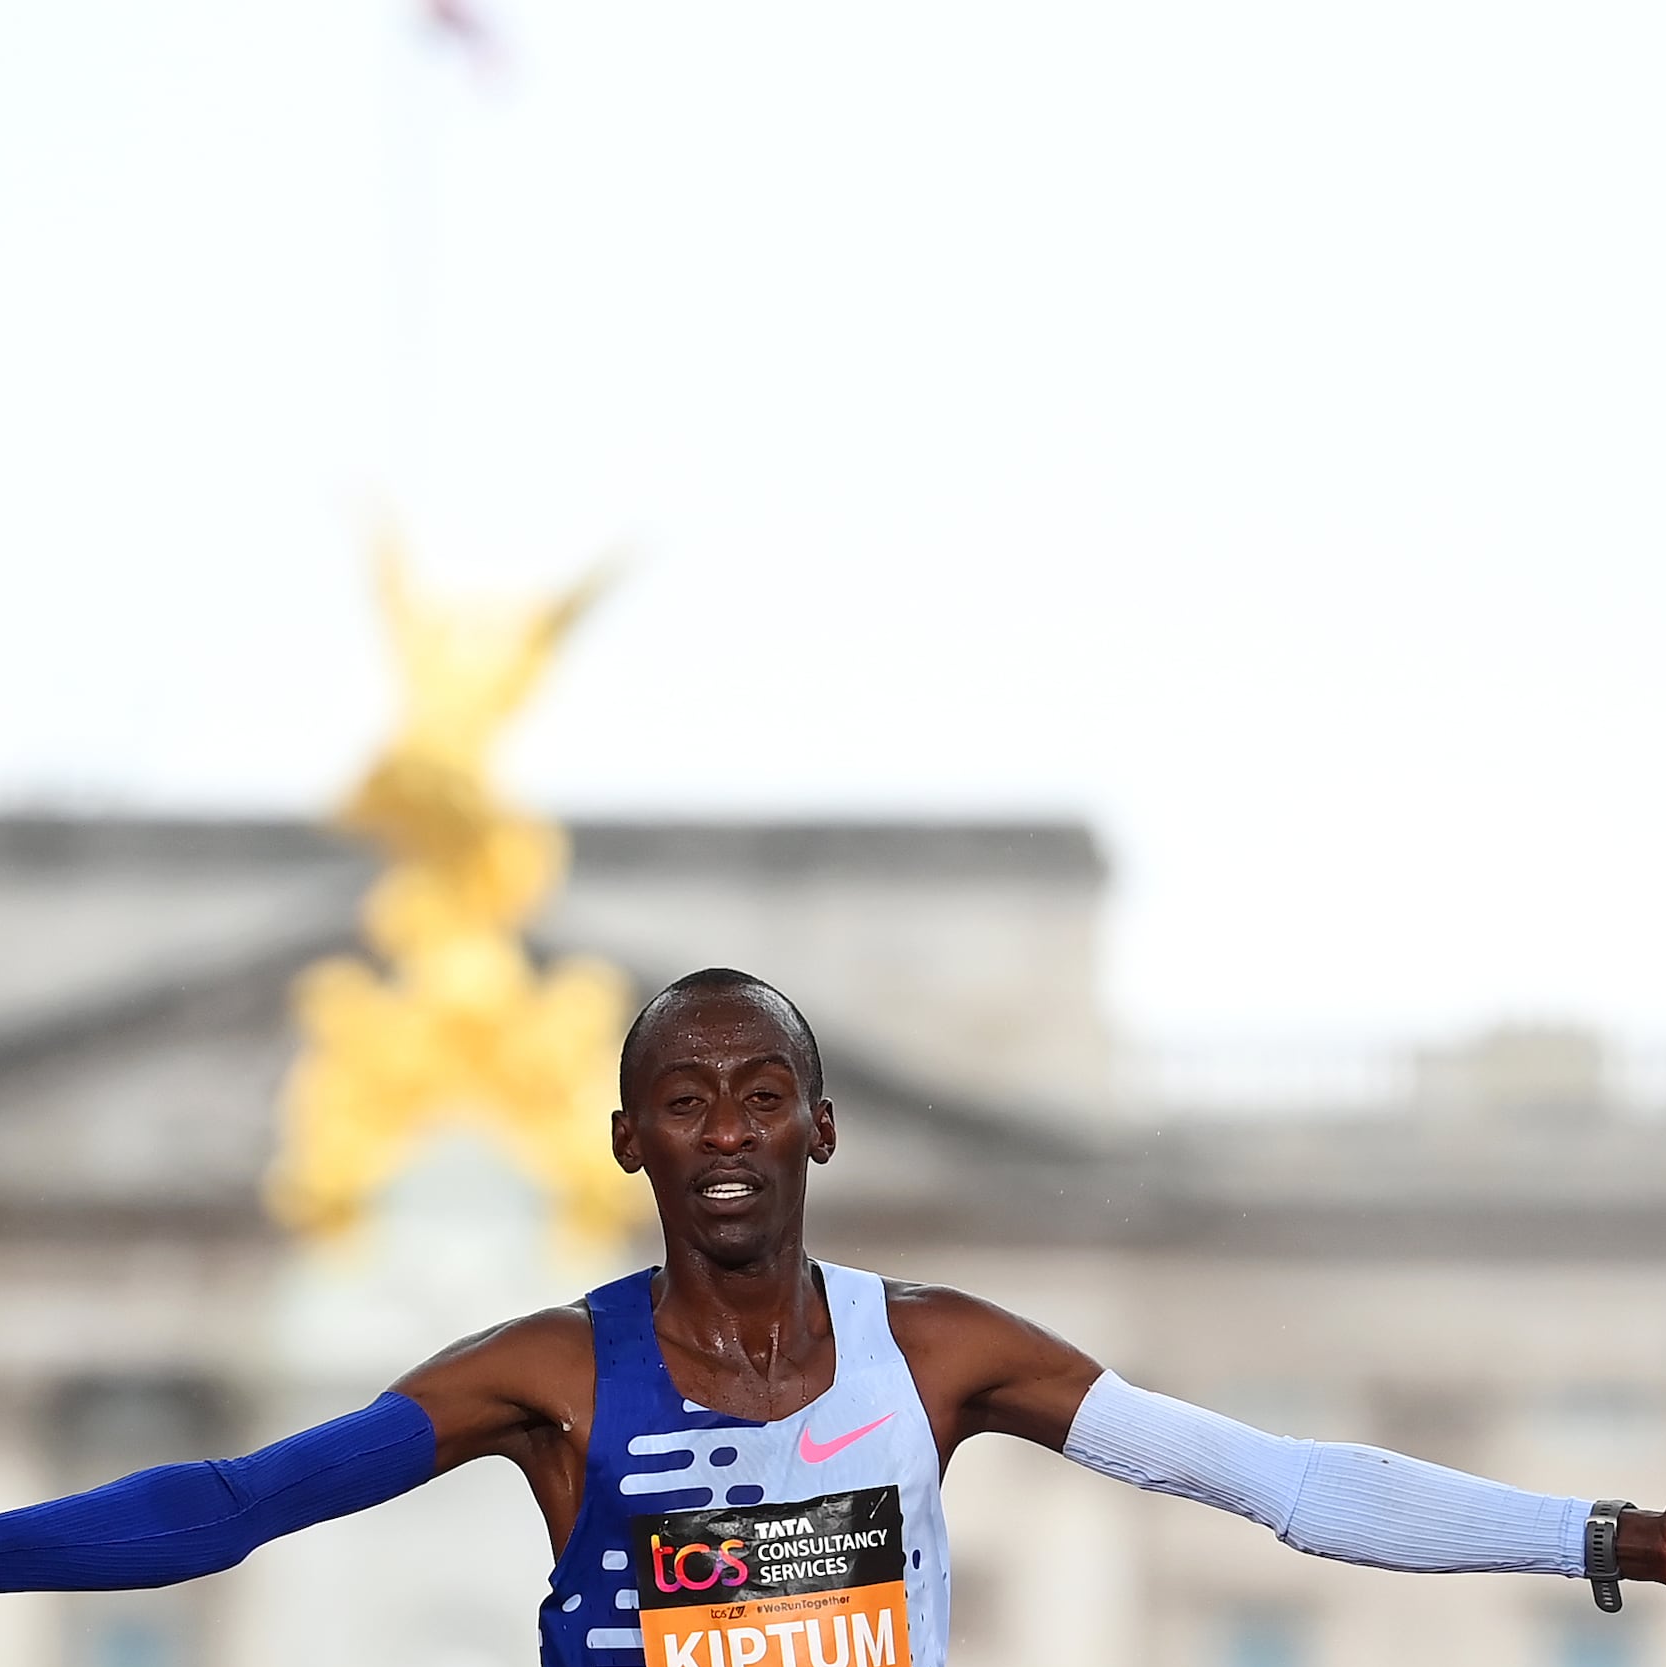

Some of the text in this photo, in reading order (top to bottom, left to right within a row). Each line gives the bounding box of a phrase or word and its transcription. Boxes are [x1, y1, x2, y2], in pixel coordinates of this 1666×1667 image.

[754, 1518, 814, 1539] TATA
[757, 1529, 888, 1562] CONSULTANCY
[651, 1534, 749, 1593] tcs
[760, 1556, 849, 1584] SERVICES
[756, 1595, 850, 1614] #WeRunTogether
